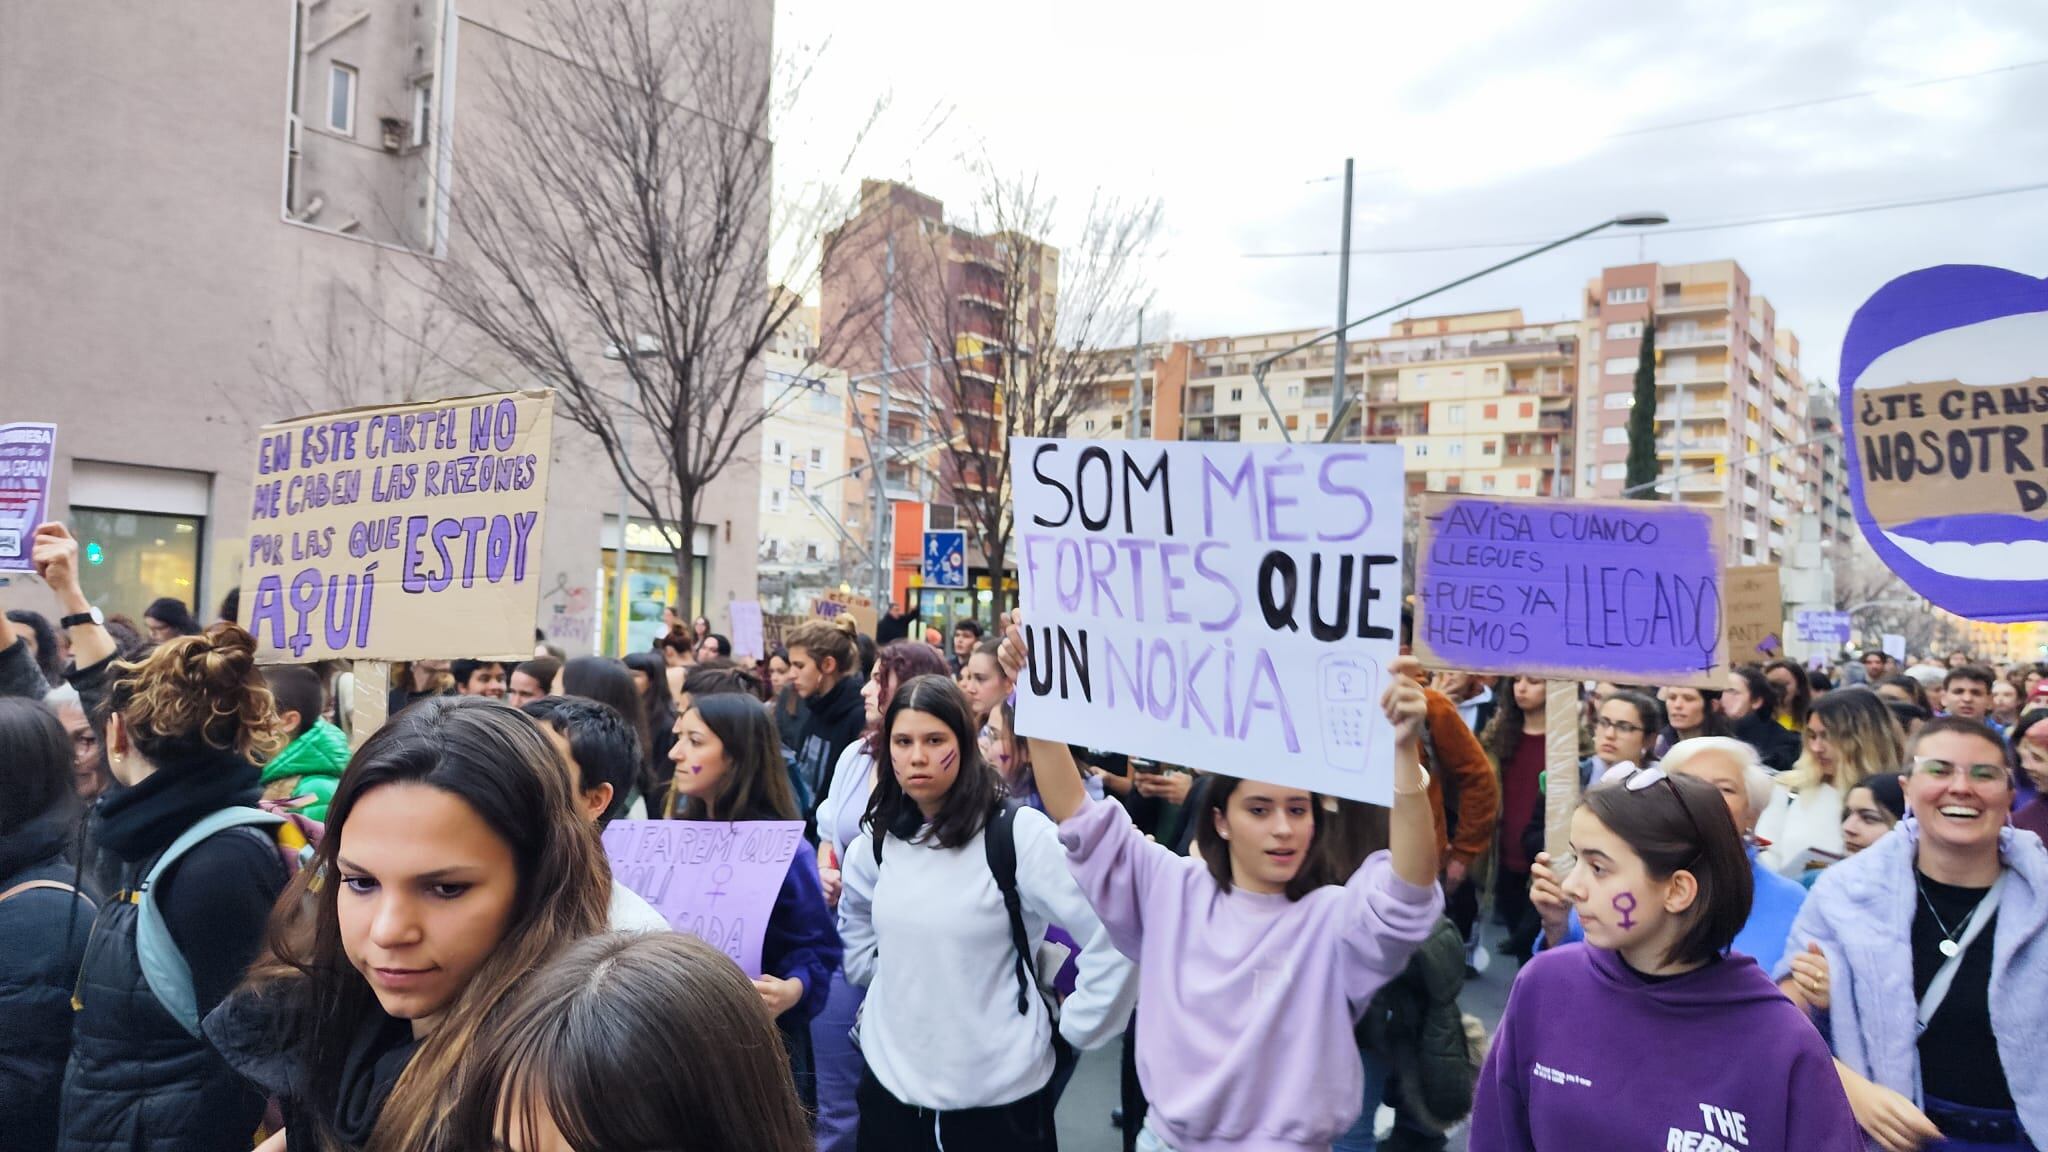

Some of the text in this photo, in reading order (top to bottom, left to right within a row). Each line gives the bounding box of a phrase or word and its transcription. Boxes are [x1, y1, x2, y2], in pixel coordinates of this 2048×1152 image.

[258, 398, 517, 475] EN ESTE CARTEL NO
[1861, 393, 1925, 425] ¿TE
[1863, 424, 2048, 482] NOSOTR
[286, 469, 361, 515] CABEN
[371, 464, 419, 503] LAS
[425, 453, 538, 498] RAZONES
[1032, 443, 1374, 543] SOM MÉS
[249, 511, 538, 594] POR LAS QUE ESTOY
[1550, 511, 1659, 545] CUANDO
[1024, 533, 1399, 642] FORTES QUE
[1432, 544, 1545, 573] LLEGUES
[1427, 614, 1531, 654] HEMOS
[1564, 564, 1723, 678] LLEGADO
[1516, 585, 1558, 615] YA
[1025, 624, 1092, 703] UN
[1103, 637, 1301, 754] NOKIA
[637, 826, 738, 865] FAREM
[740, 827, 801, 865] QUE
[1666, 1127, 1740, 1152] REB
[1699, 1103, 1749, 1145] THE
